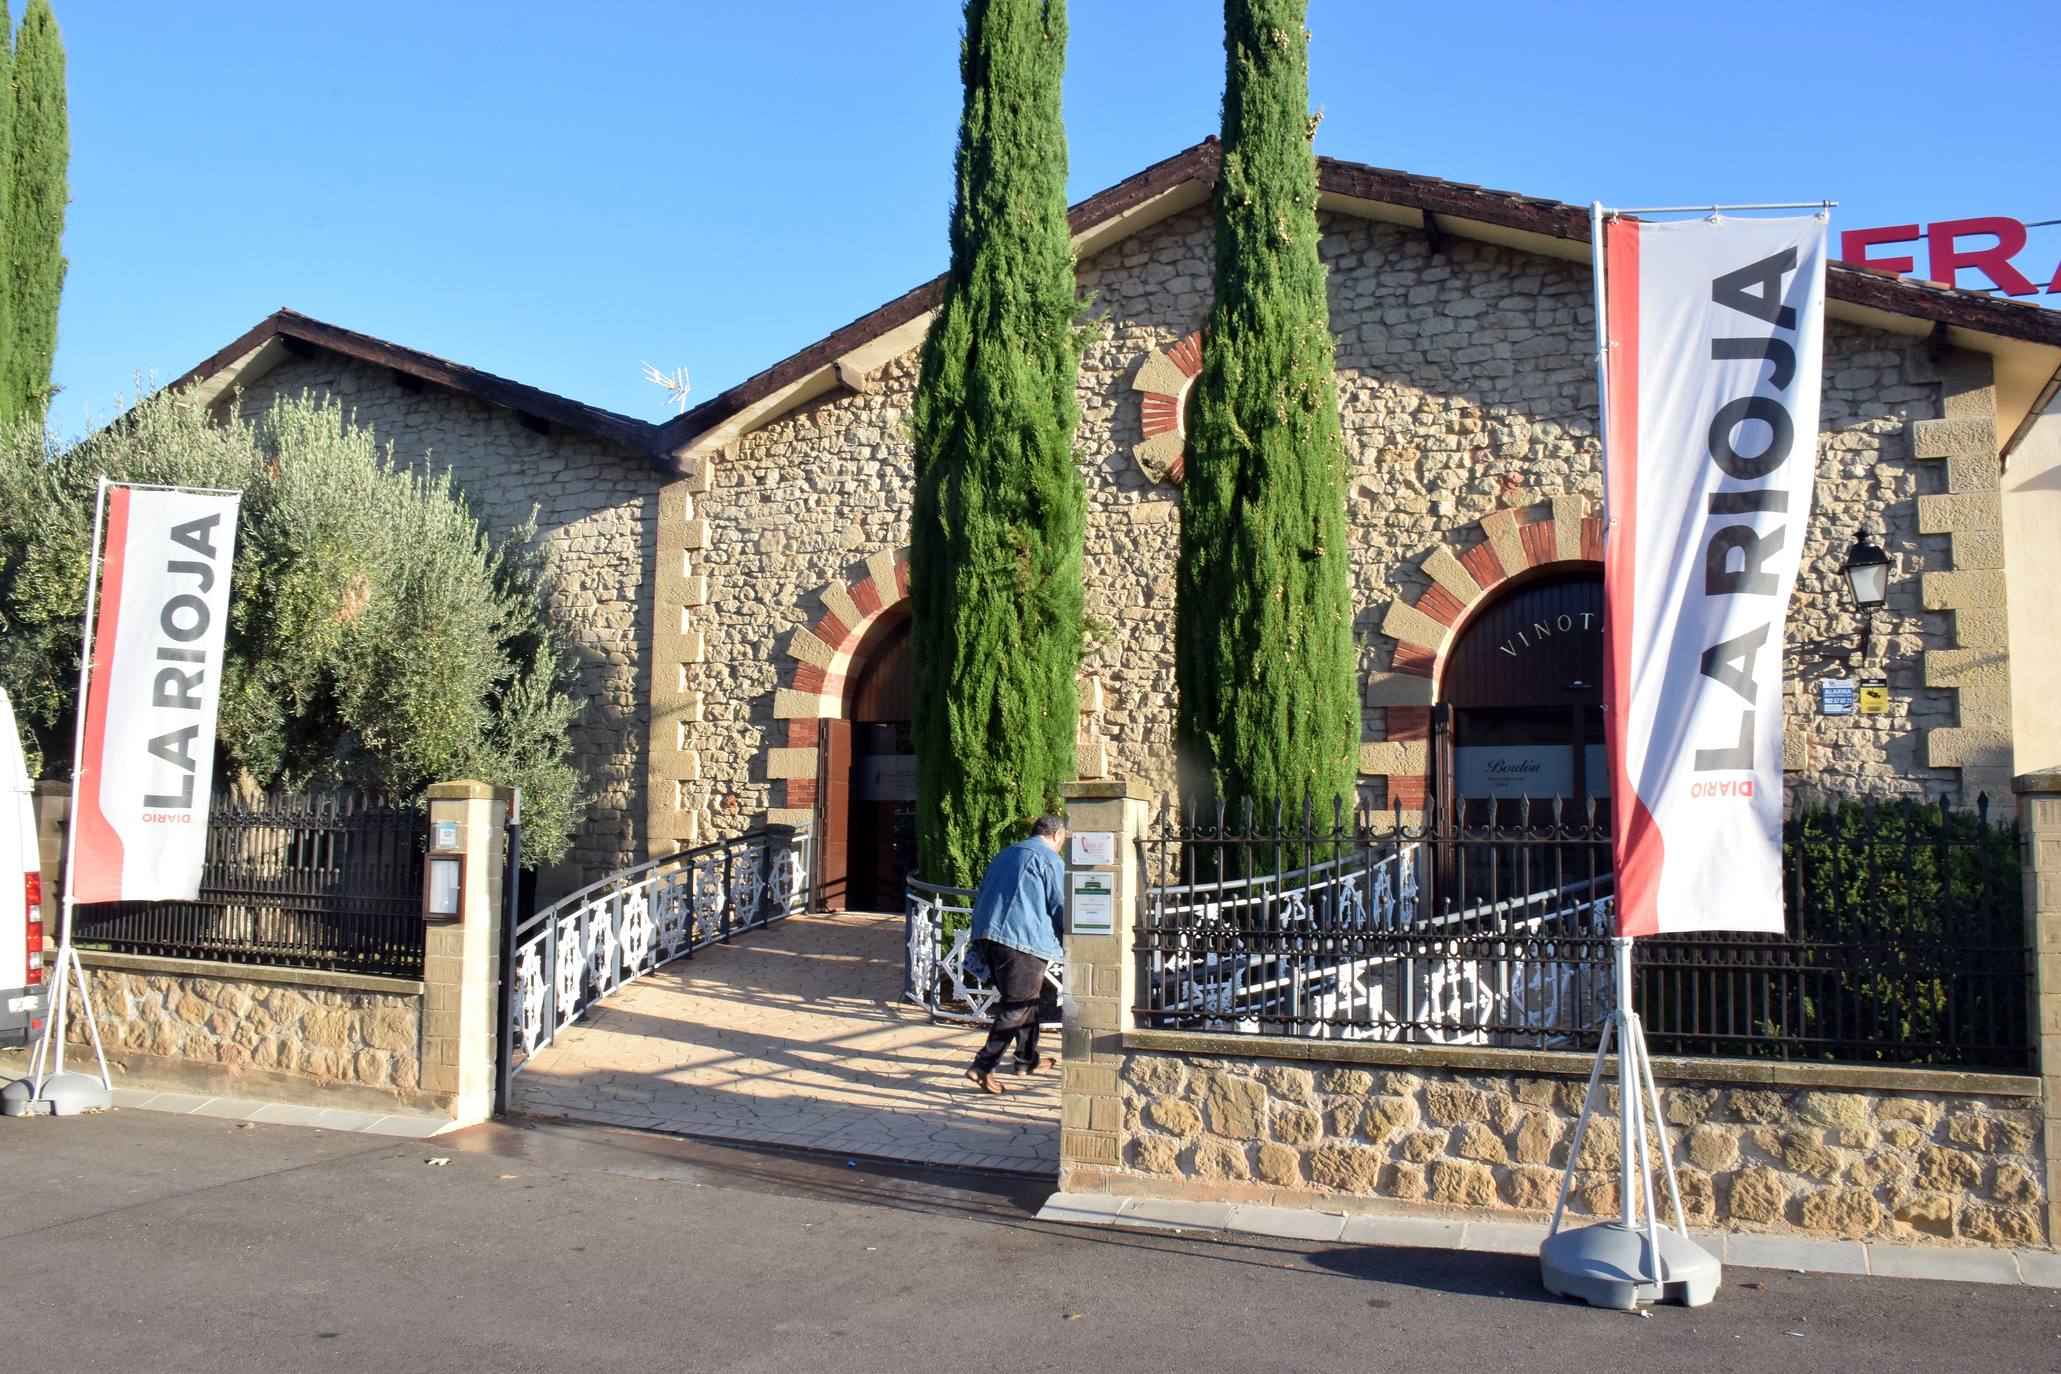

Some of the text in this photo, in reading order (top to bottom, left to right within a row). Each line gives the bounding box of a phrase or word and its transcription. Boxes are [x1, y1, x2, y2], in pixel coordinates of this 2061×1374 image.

[1841, 216, 2061, 297] FR
[1694, 245, 1798, 771] LA RIOJA
[143, 512, 221, 809] LA RIOJA
[1499, 612, 1605, 657] VINOT
[141, 813, 192, 825] DIARIO
[1690, 780, 1753, 798] DIARIO
